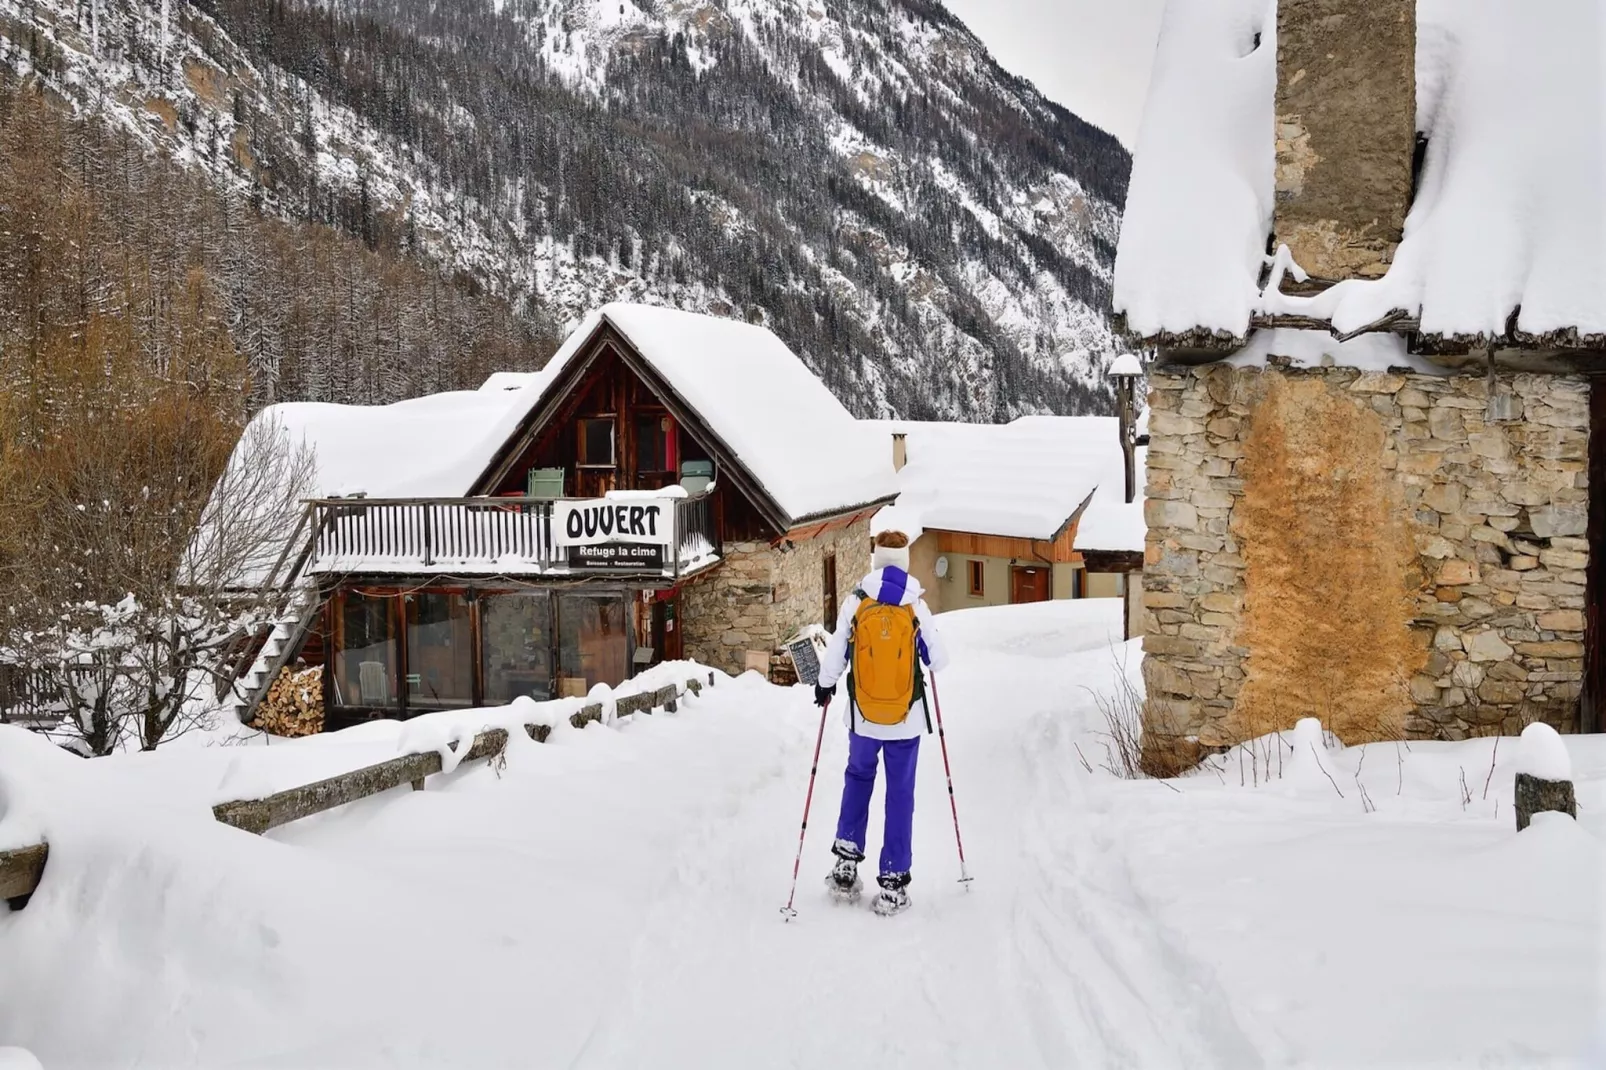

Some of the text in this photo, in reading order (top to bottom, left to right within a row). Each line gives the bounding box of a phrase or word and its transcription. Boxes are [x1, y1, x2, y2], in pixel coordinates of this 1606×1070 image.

[567, 505, 660, 538] OUVERT
[579, 546, 657, 558] Refuge la cime
